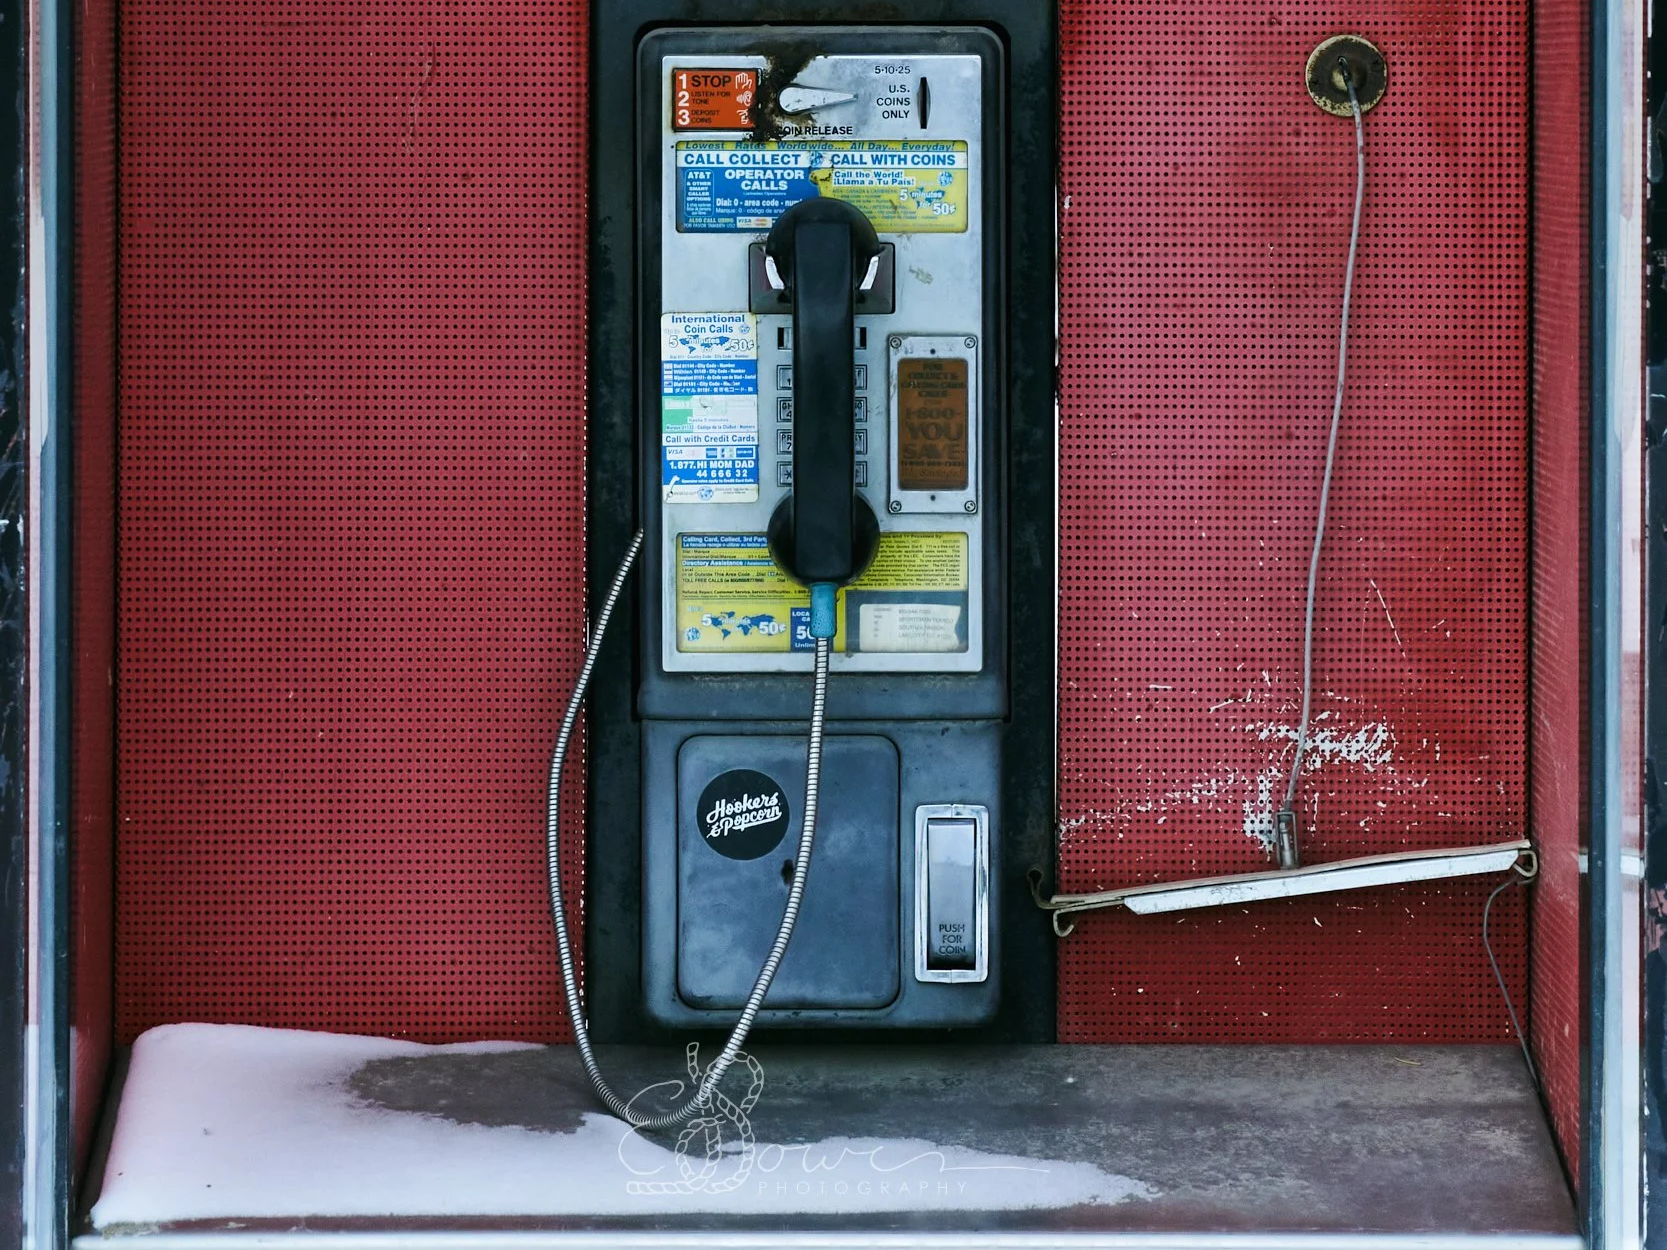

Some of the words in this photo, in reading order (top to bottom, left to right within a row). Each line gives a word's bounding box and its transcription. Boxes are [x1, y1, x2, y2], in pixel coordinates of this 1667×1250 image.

[678, 73, 687, 89] 1
[691, 75, 732, 88] STOP
[888, 84, 910, 94] U.S.
[678, 91, 690, 107] 2
[876, 97, 911, 106] COINS
[678, 109, 690, 126] 3
[882, 110, 910, 120] ONLY
[805, 126, 853, 135] RELEASE
[685, 141, 725, 150] Lowest
[735, 141, 766, 150] Rates
[850, 141, 865, 150] All
[901, 141, 955, 150] Everyday!
[684, 153, 724, 165] CALL
[728, 153, 801, 165] COLLECT
[831, 154, 867, 166] CALL
[870, 154, 908, 166] WITH
[911, 154, 956, 166] COINS
[687, 171, 712, 179] AT&T
[724, 169, 805, 180] OPERATOR
[741, 180, 788, 191] CALLS
[900, 189, 908, 201] 5
[716, 198, 732, 207] Dial:
[733, 198, 739, 207] 0
[744, 198, 760, 207] area
[761, 198, 779, 207] code
[932, 203, 956, 215] 50¢
[671, 314, 745, 323] International
[684, 324, 706, 333] Coin
[709, 324, 733, 333] Calls
[668, 334, 679, 348] 5
[730, 339, 755, 352] 50¢
[905, 421, 964, 441] YOU
[665, 435, 681, 443] Call
[684, 435, 702, 443] with
[704, 435, 729, 443] Credit
[731, 435, 756, 443] Cards
[786, 442, 792, 450] 7
[709, 460, 732, 469] MOM
[734, 460, 755, 469] DAD
[696, 469, 708, 478] 44
[701, 613, 712, 627] 5
[759, 621, 786, 635] 50¢
[705, 792, 779, 824] Hookers
[720, 805, 783, 837] Popcorn
[938, 923, 965, 933] PUSH
[941, 934, 963, 944] FOR
[938, 945, 966, 955] COIN
